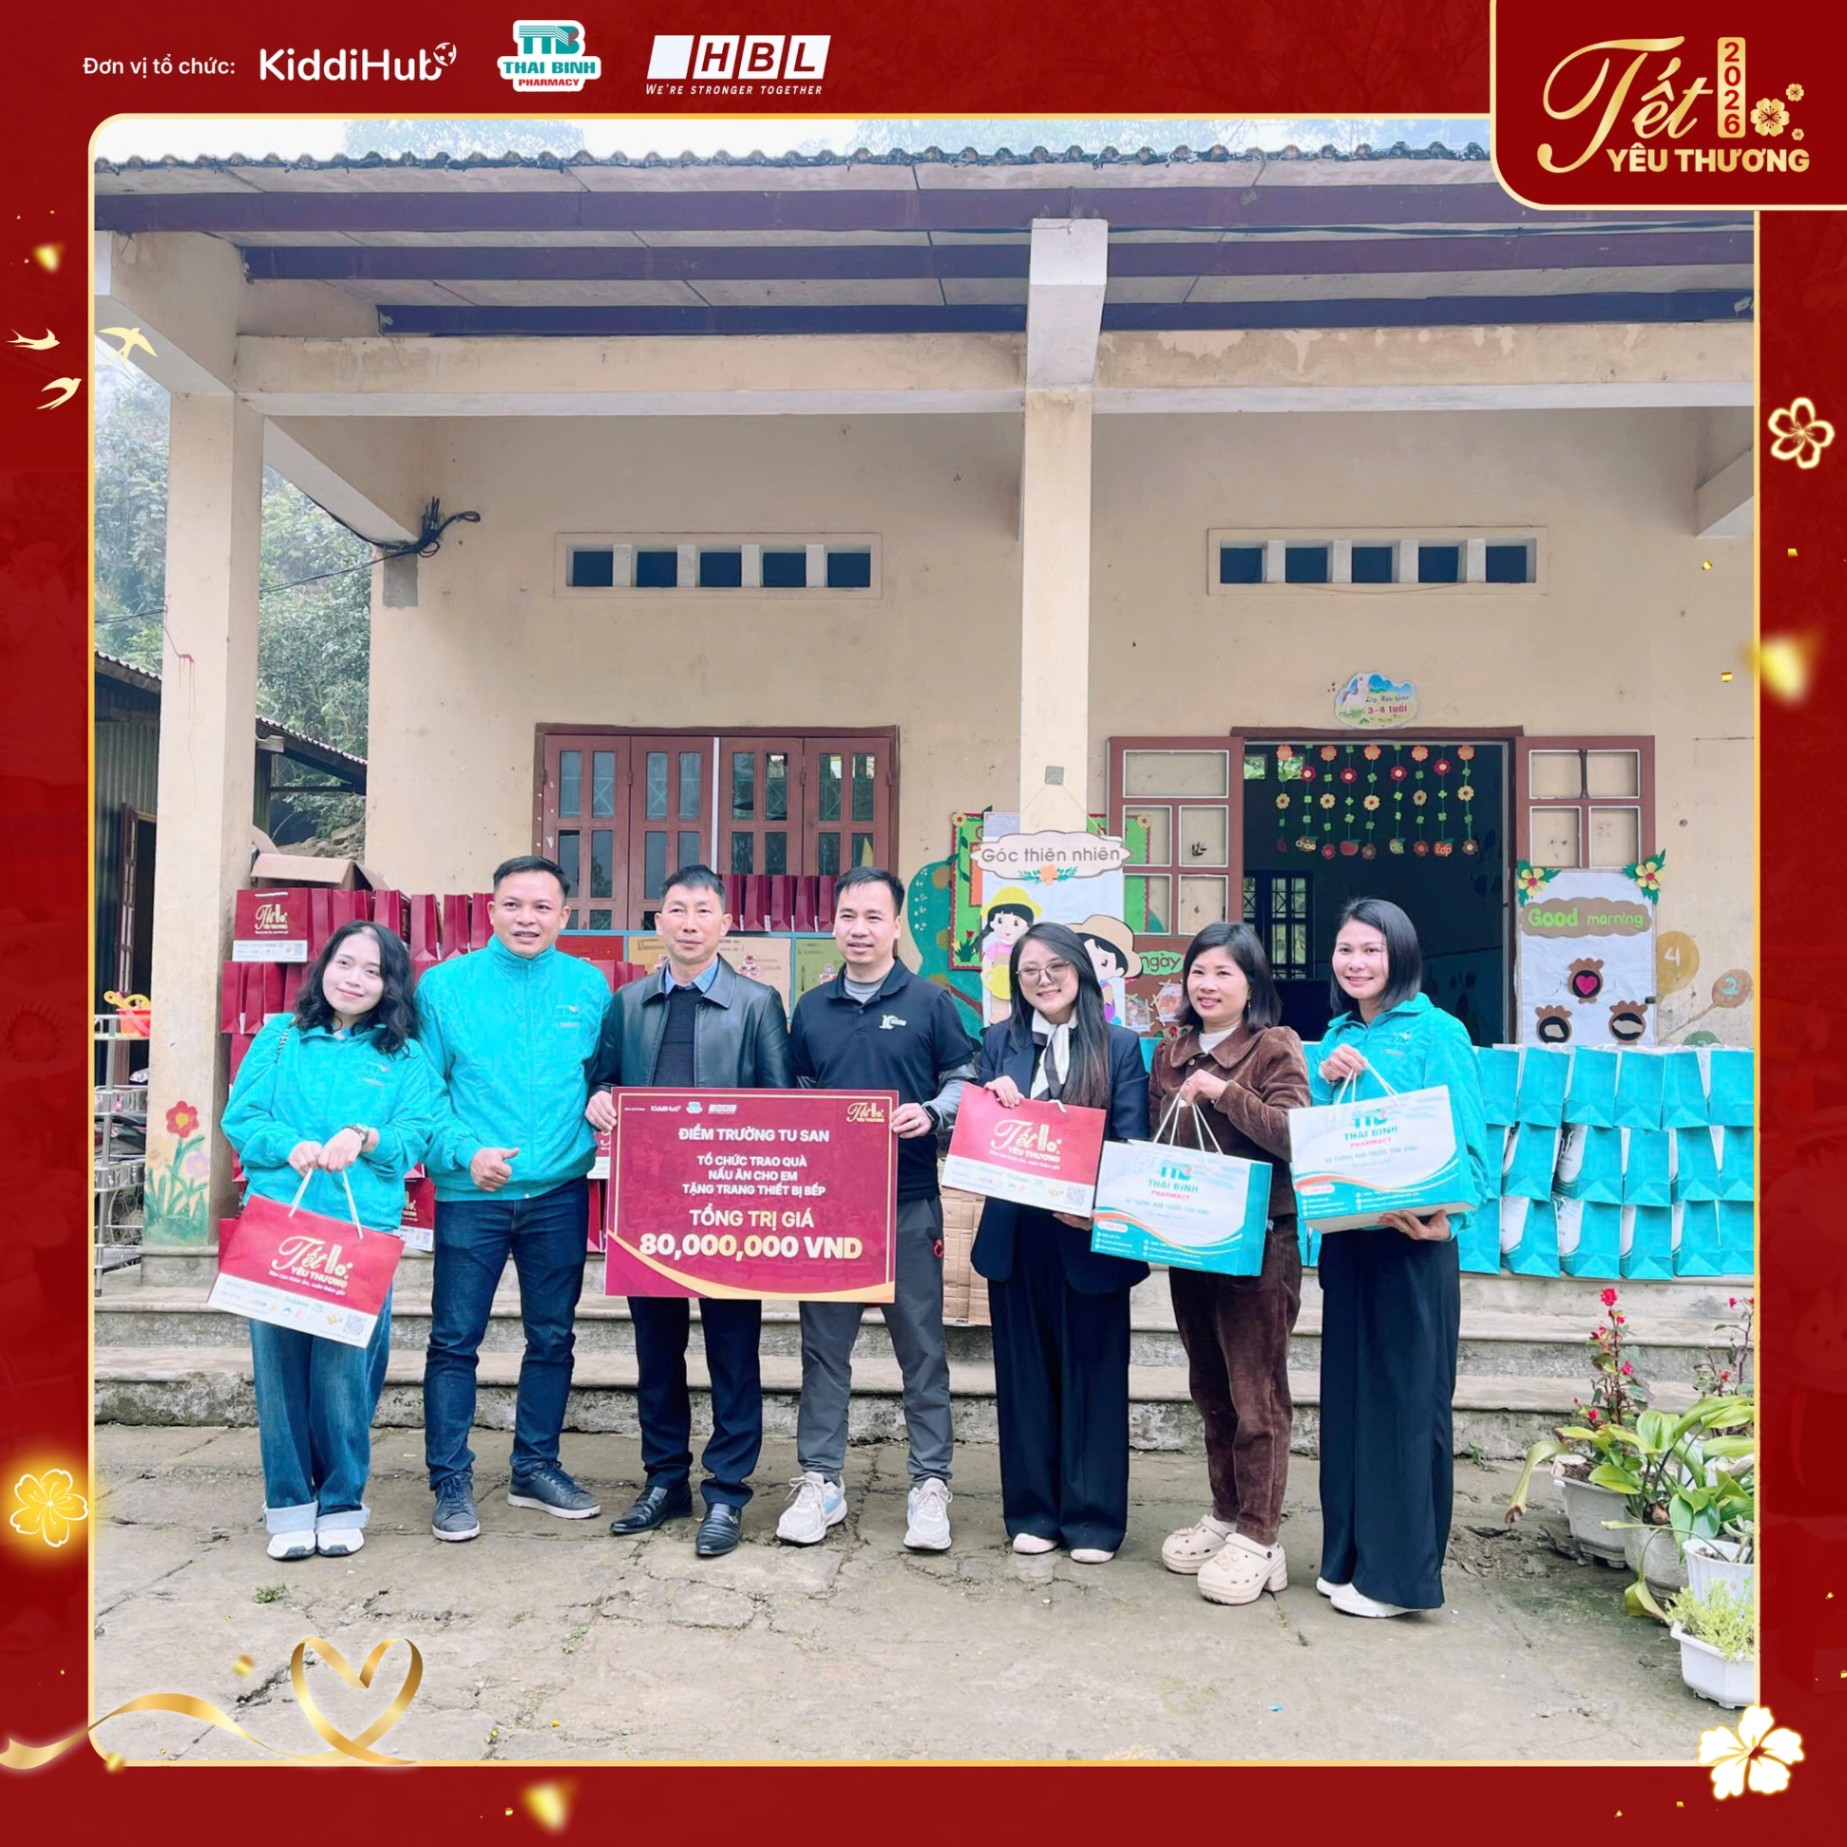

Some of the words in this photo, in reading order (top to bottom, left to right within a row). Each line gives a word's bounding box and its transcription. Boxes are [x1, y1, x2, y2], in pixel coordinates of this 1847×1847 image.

[981, 847, 1019, 863] Góc
[1024, 847, 1067, 863] thiên
[1072, 846, 1121, 862] nhiên
[1527, 906, 1579, 928] Good
[1587, 912, 1644, 929] morning
[1139, 952, 1182, 972] ngày
[1663, 946, 1681, 968] 4
[1721, 975, 1740, 996] 2
[678, 1123, 714, 1141] ĐIỂM
[716, 1126, 776, 1142] TRƯỜNG
[778, 1129, 797, 1142] TU
[799, 1129, 830, 1143] SAN
[697, 1151, 713, 1166] TỔ
[715, 1153, 748, 1167] CHỨC
[749, 1156, 781, 1167] TRAO
[782, 1154, 808, 1168] QUÀ
[708, 1166, 733, 1181] NẤU
[735, 1168, 751, 1181] ĂN
[753, 1170, 778, 1182] CHO
[780, 1170, 798, 1182] EM
[682, 1181, 714, 1197] TẶNG
[717, 1183, 756, 1196] TRANG
[757, 1181, 790, 1196] THIẾT
[791, 1185, 803, 1198] BỊ
[804, 1181, 826, 1197] BẾP
[689, 1202, 744, 1227] TỔNG
[748, 1209, 777, 1232] TRỊ
[781, 1207, 815, 1229] GIÁ
[639, 1232, 799, 1262] 80,000,000
[803, 1235, 863, 1260] VND
